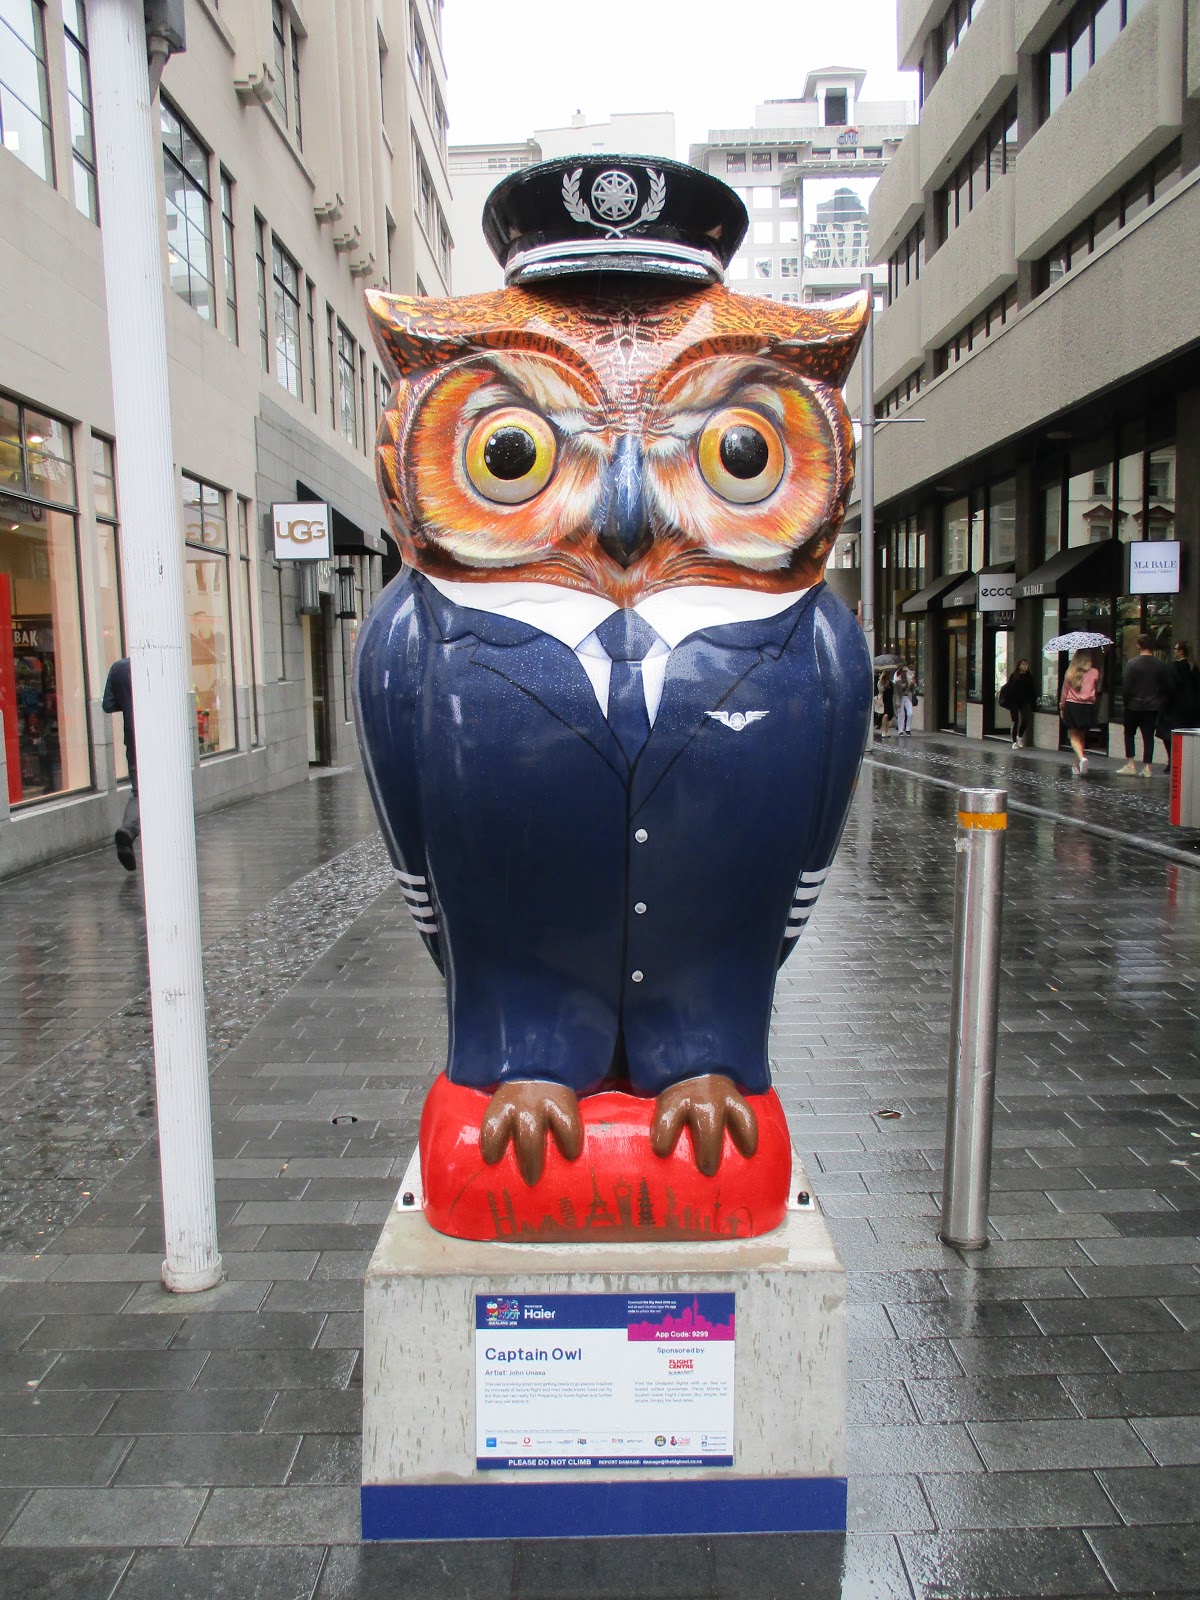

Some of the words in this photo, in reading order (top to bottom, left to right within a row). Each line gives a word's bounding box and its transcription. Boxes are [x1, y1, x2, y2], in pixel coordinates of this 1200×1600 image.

[837, 131, 858, 144] citi
[276, 520, 326, 544] UGG
[1151, 560, 1177, 568] BALE
[1030, 584, 1044, 596] BALE
[524, 1308, 556, 1318] Haier
[486, 1348, 548, 1362] Captain
[552, 1348, 582, 1360] Owl
